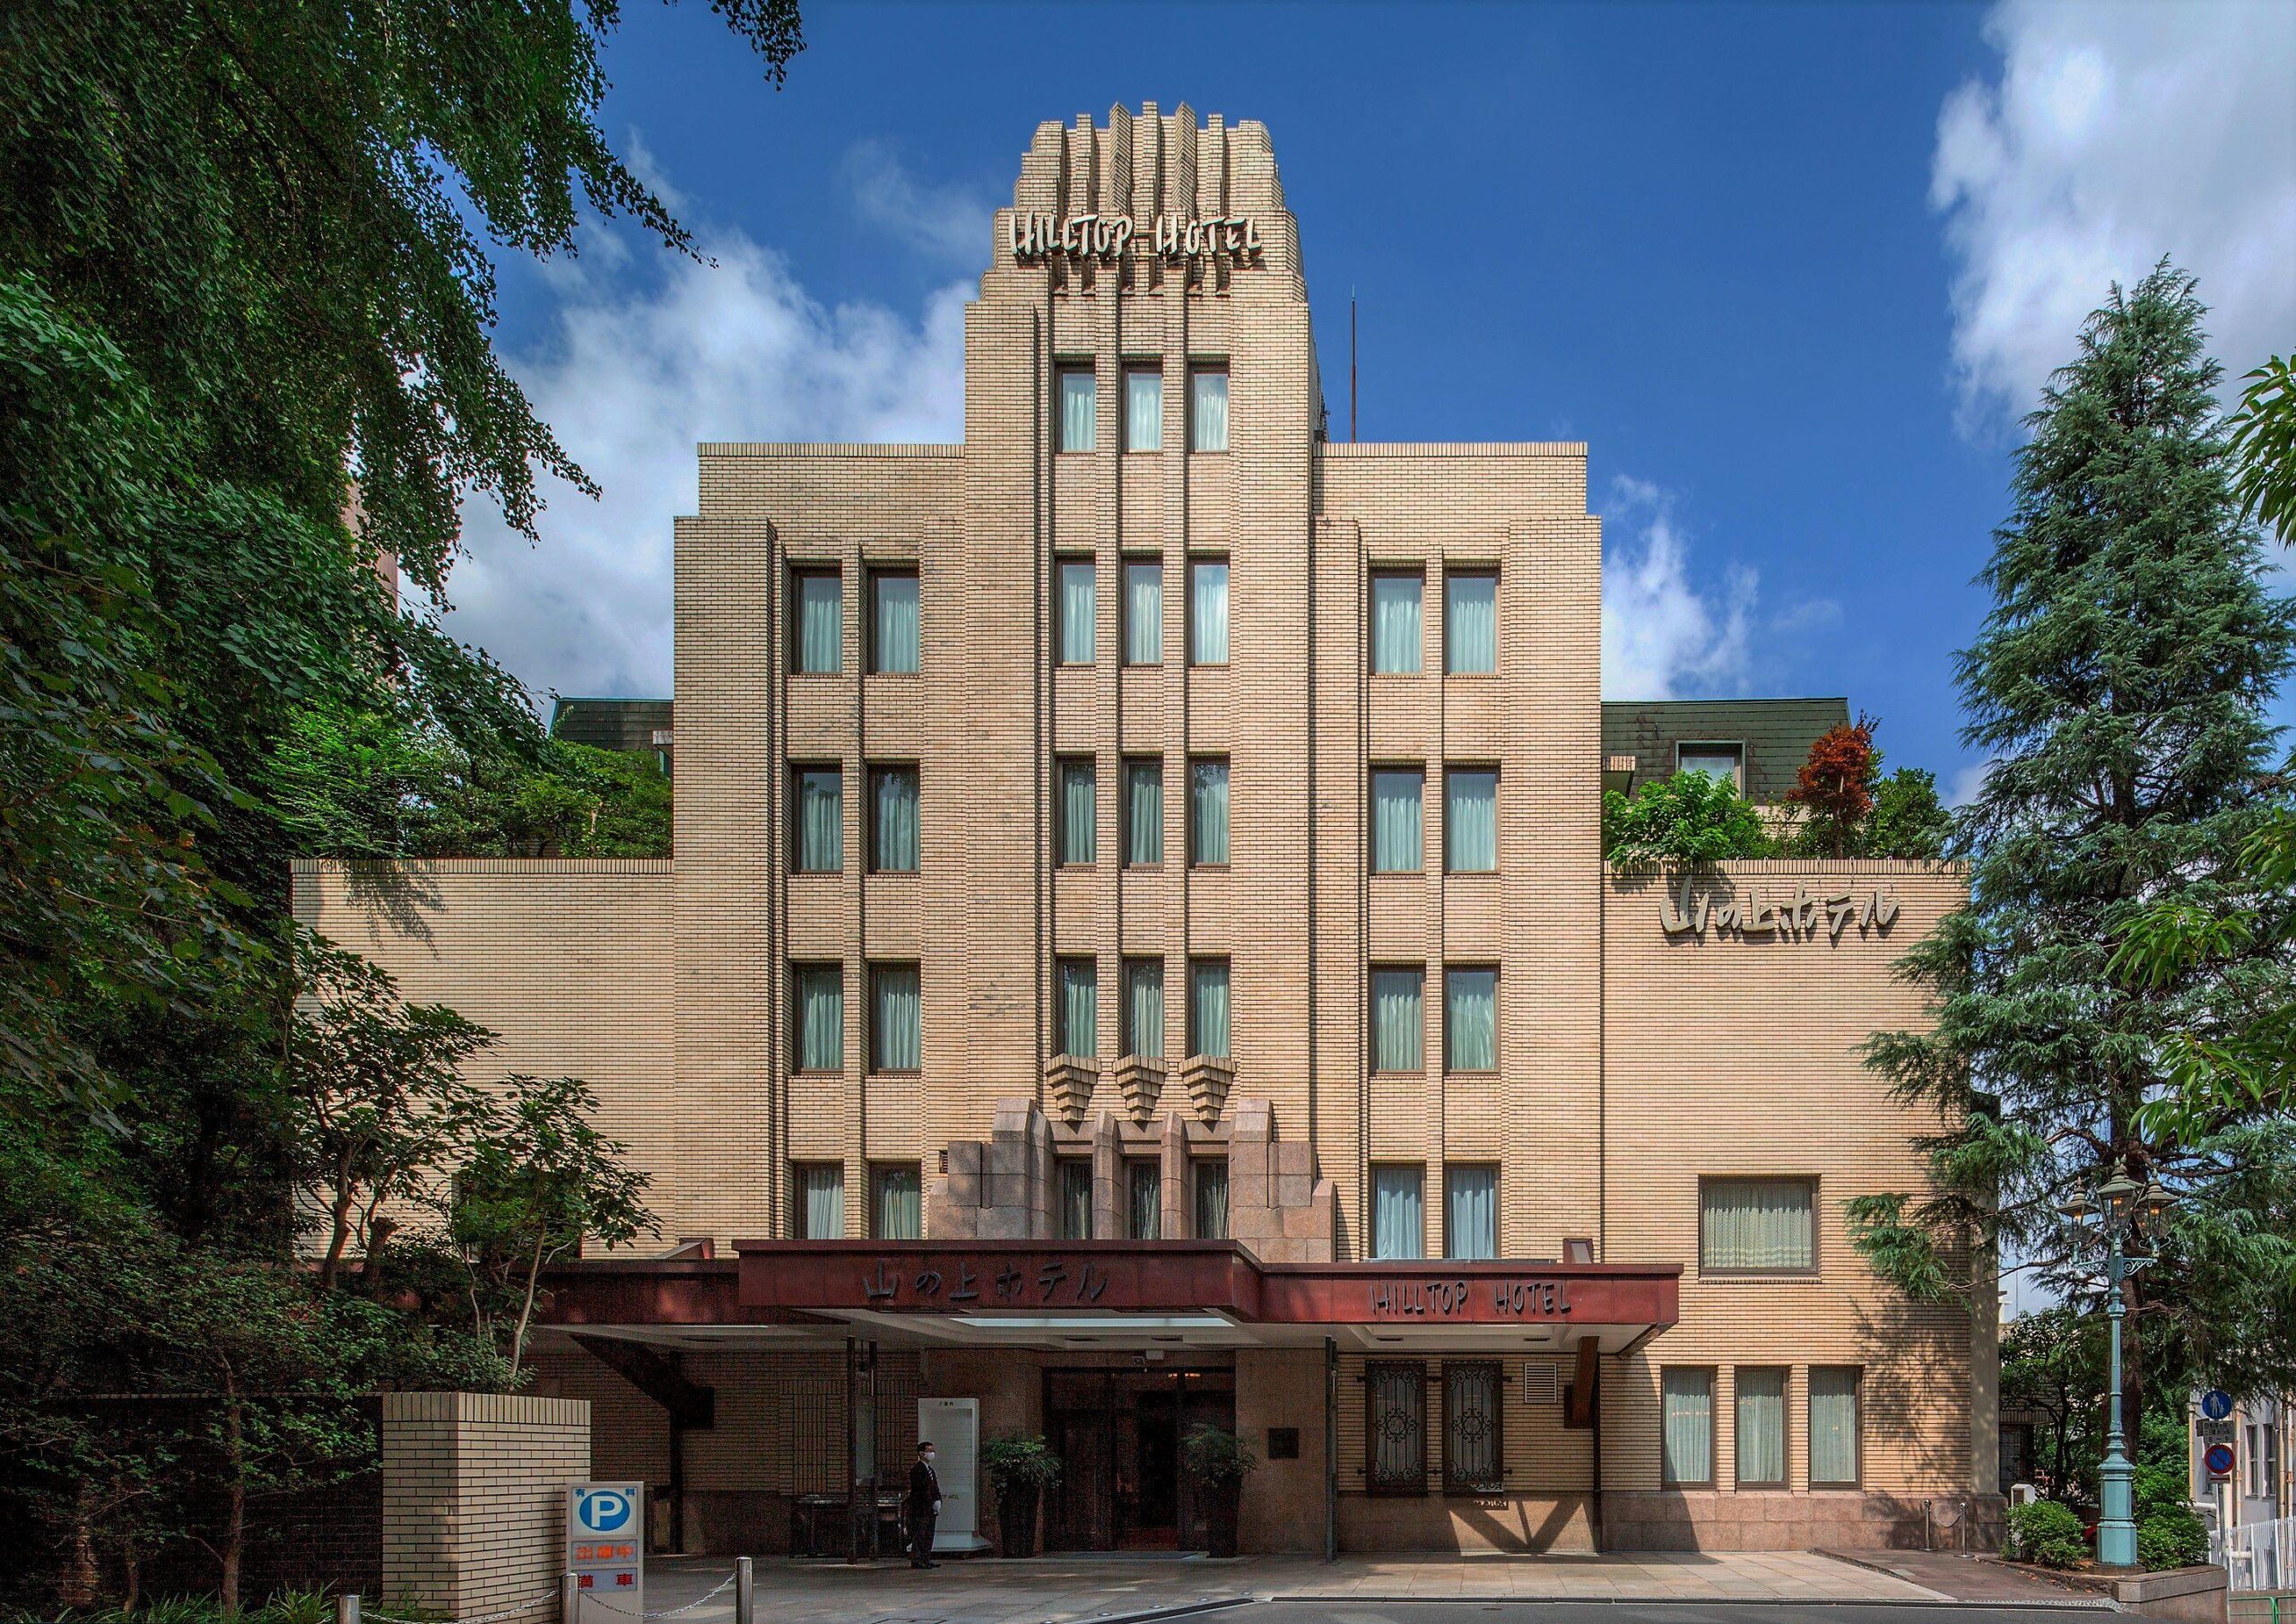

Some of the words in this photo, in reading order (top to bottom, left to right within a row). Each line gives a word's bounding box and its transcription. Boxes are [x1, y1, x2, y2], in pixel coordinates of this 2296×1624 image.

[1008, 211, 1133, 256] HILLTOP
[1154, 213, 1262, 255] HOTEL
[1658, 873, 1900, 936] 山の上ホテル
[862, 1257, 1109, 1300] 山の上ホテル
[1370, 1279, 1468, 1315] HILLTOP
[1493, 1279, 1571, 1315] HOTEL
[591, 1495, 623, 1528] P
